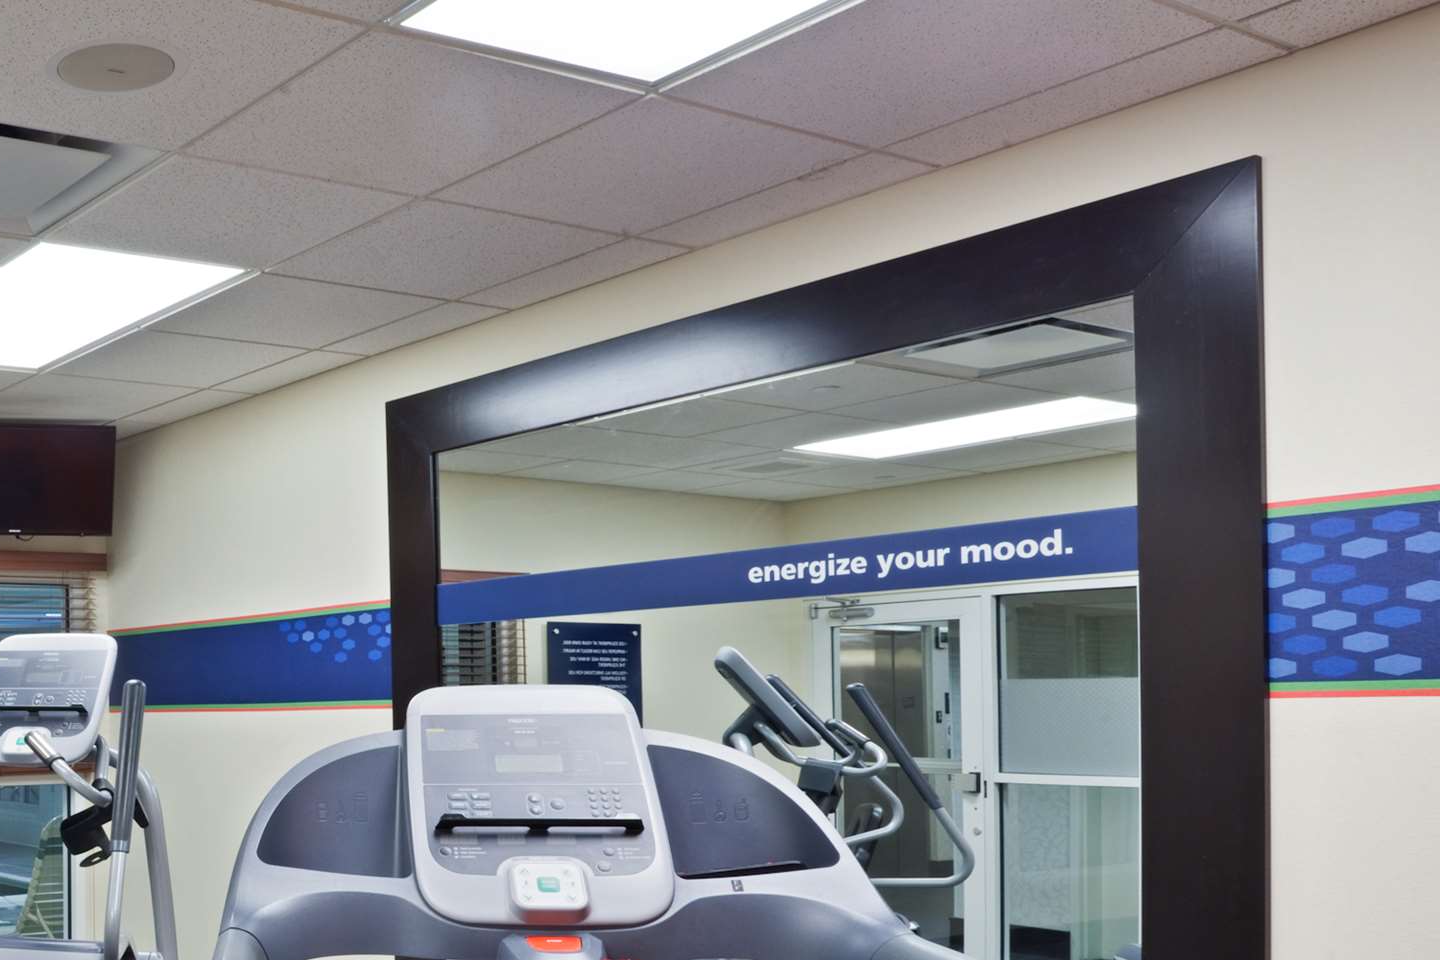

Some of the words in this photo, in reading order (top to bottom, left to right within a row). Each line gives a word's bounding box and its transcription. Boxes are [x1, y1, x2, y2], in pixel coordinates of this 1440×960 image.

[747, 553, 867, 584] energize
[876, 546, 950, 578] your
[960, 528, 1073, 564] mood.
